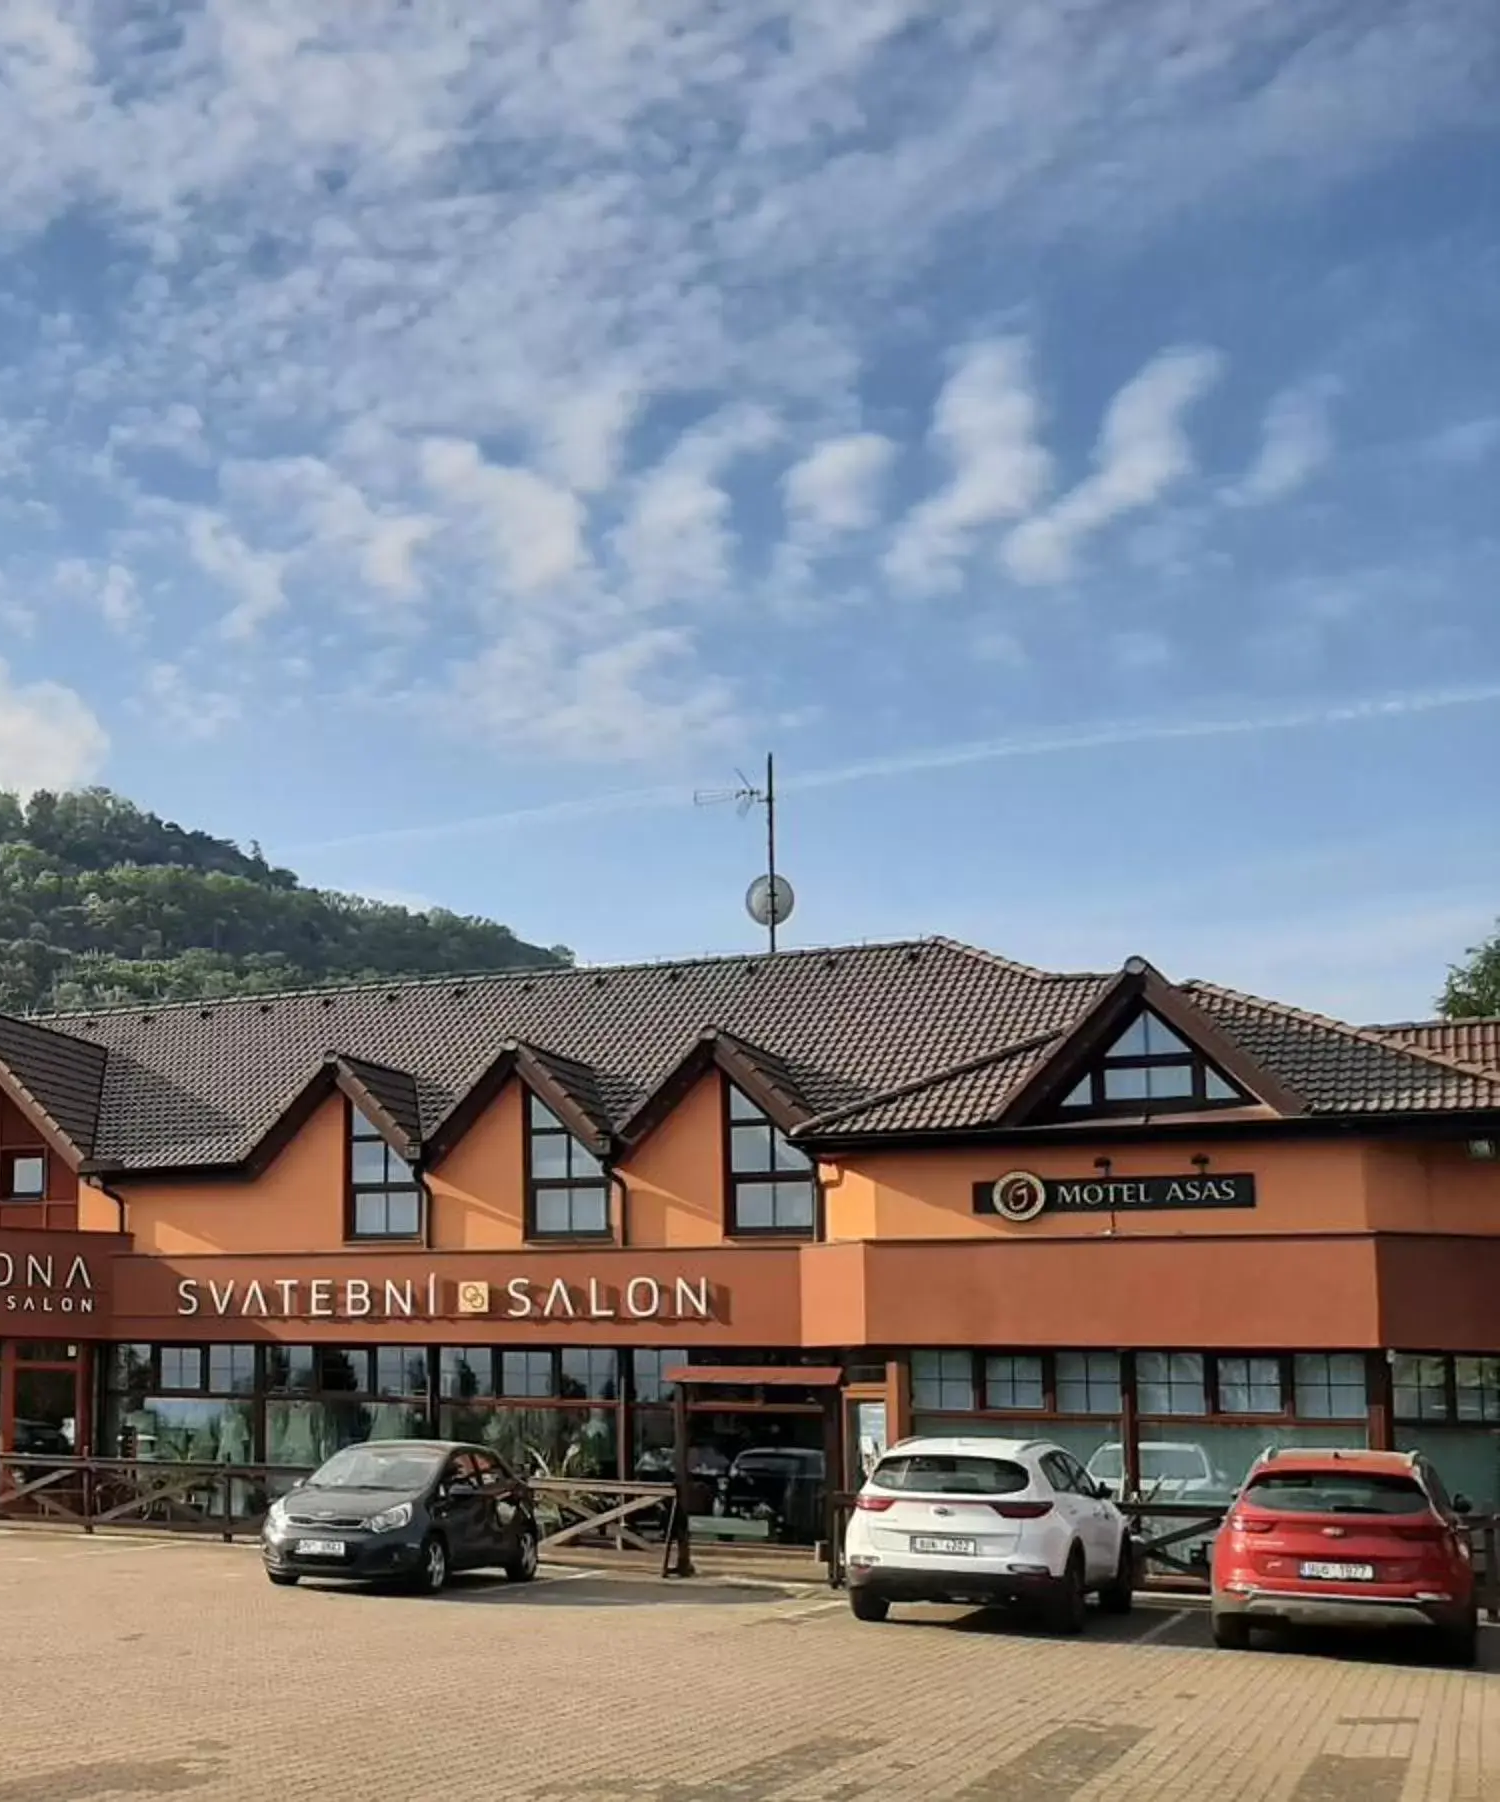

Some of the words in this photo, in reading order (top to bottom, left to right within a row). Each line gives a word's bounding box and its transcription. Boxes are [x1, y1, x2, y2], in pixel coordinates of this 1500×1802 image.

[1056, 1182, 1152, 1205] MOTEL
[1165, 1178, 1237, 1201] ASAS
[6, 1294, 93, 1313] SALON
[177, 1272, 437, 1317] SVATEBNÍ
[506, 1276, 708, 1318] SALON
